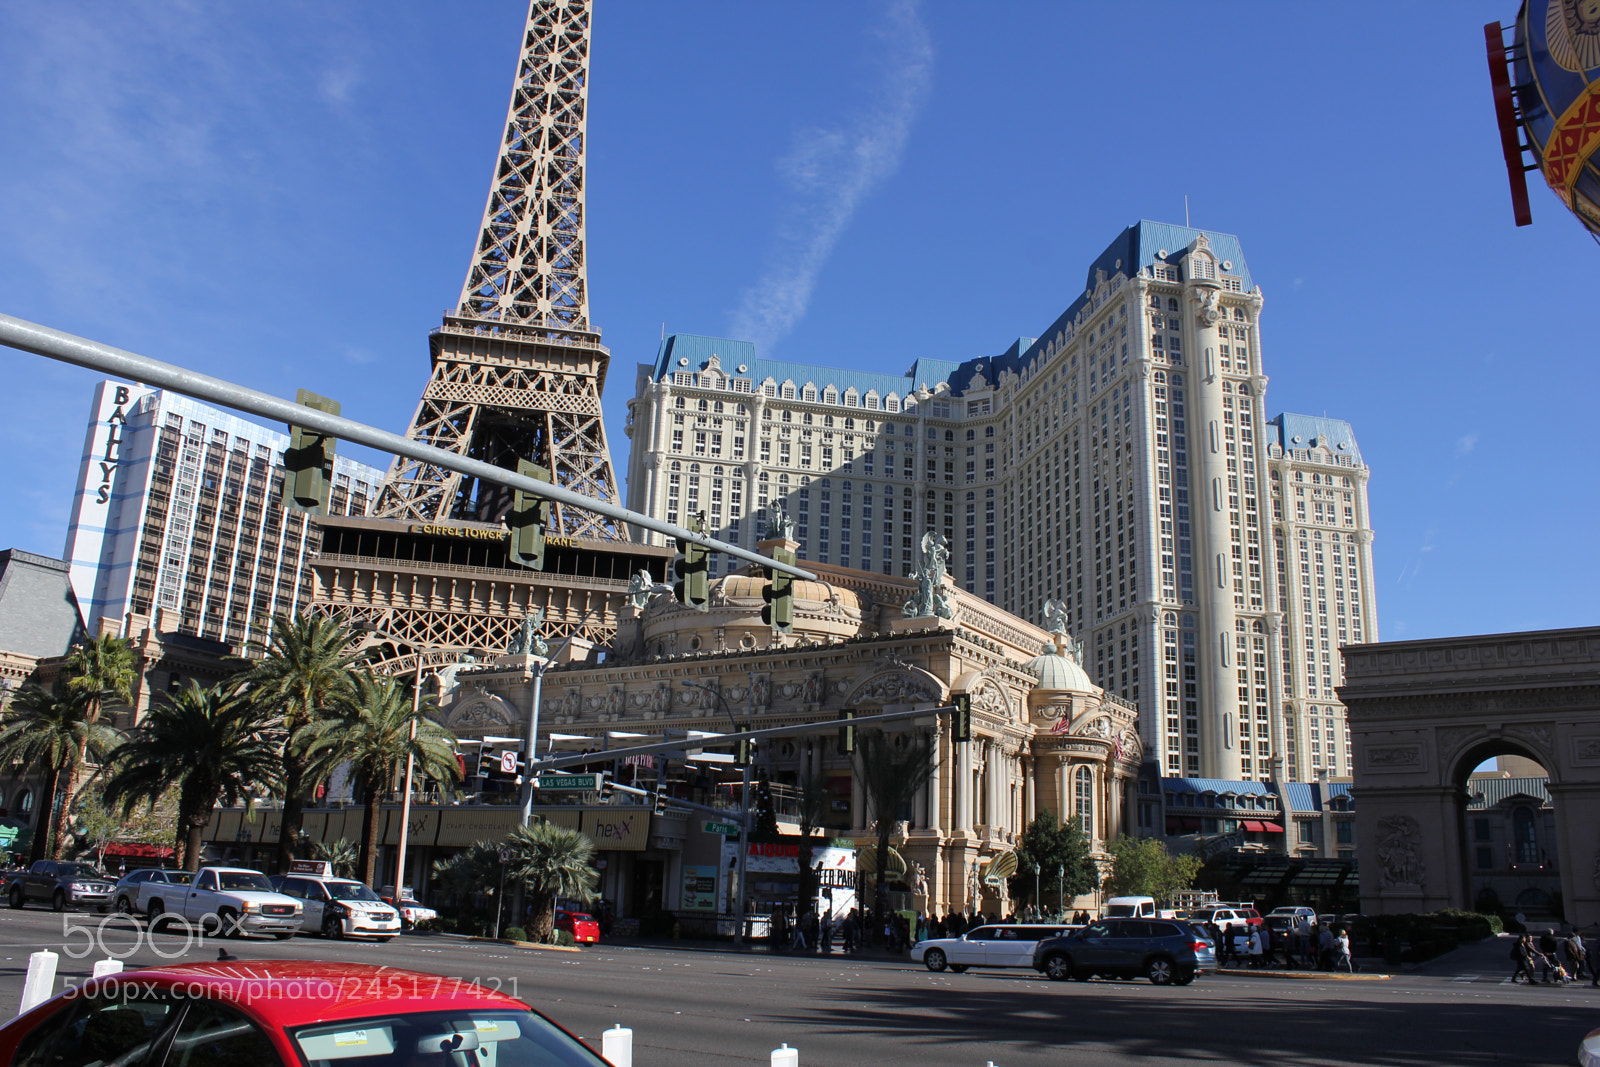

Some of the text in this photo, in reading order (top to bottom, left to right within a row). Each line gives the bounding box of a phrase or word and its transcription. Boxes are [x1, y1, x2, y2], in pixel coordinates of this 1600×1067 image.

[423, 523, 461, 537] EIFFEL
[464, 526, 503, 540] TOWER
[541, 777, 594, 787] LAS VEGAS BLVD
[596, 815, 633, 840] hexx
[712, 823, 728, 833] Paris
